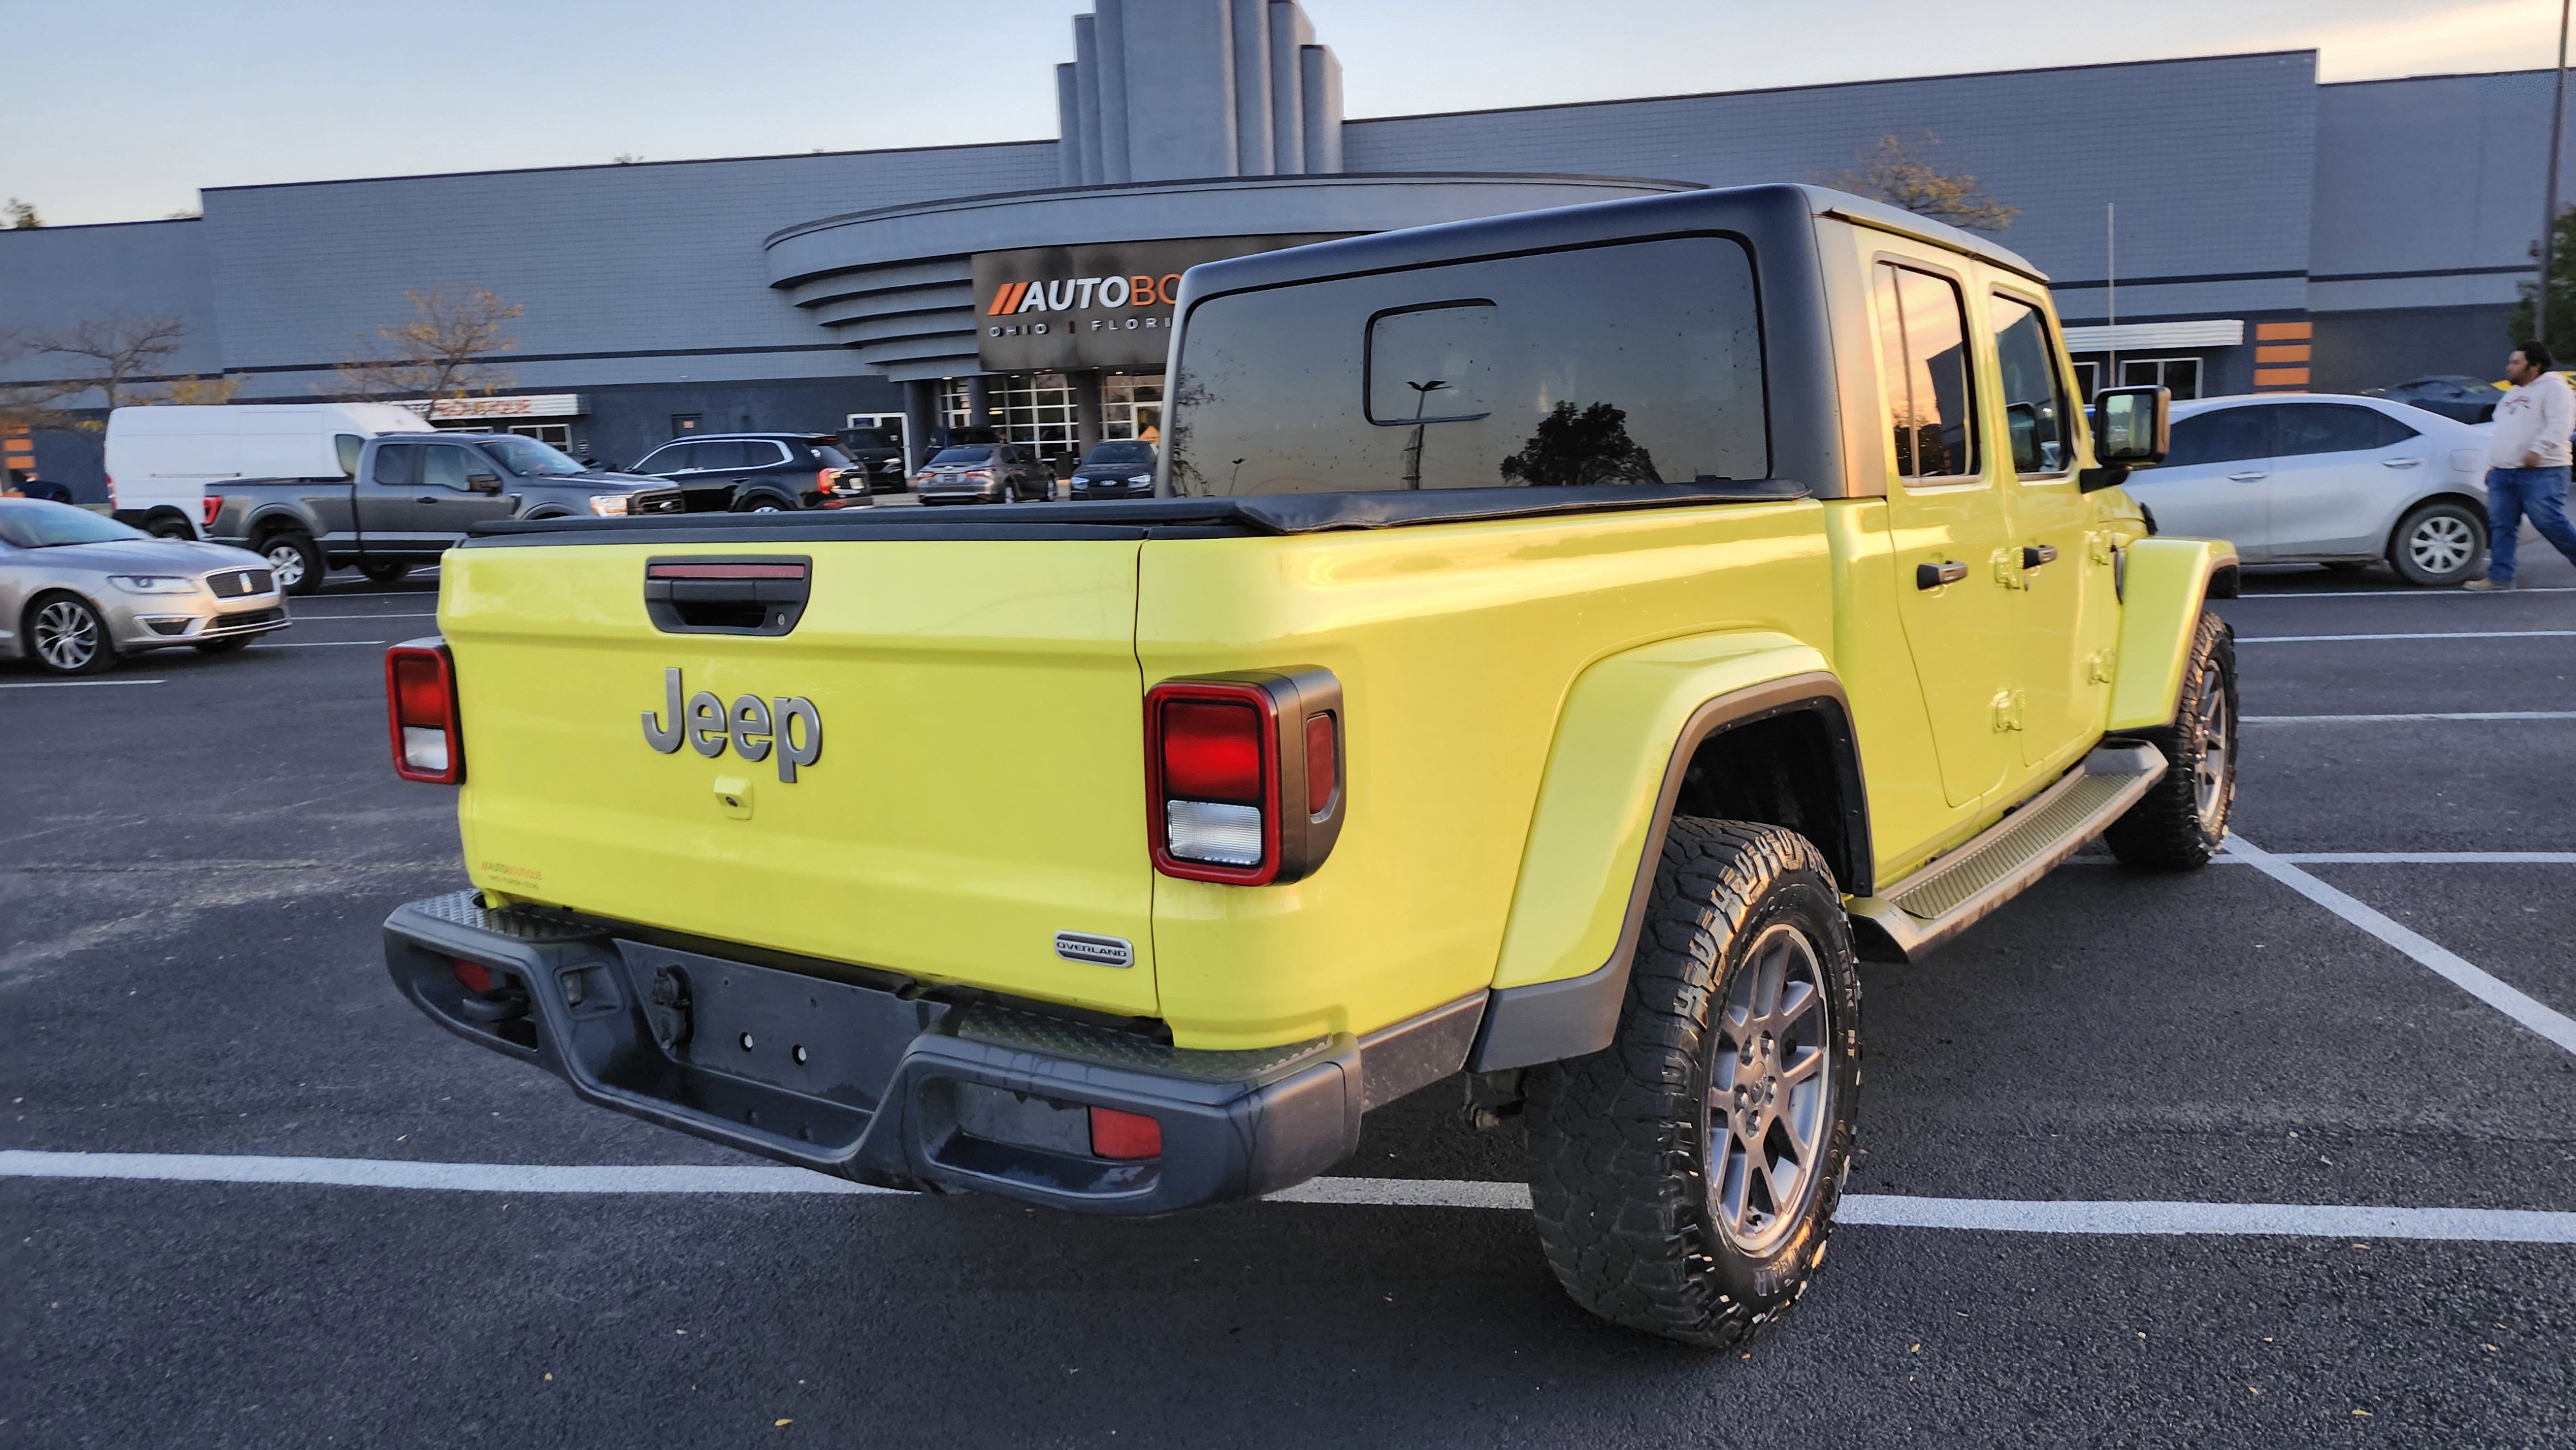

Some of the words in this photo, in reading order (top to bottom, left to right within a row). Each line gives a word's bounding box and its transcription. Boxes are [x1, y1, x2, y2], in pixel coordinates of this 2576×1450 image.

[989, 323, 1048, 337] OHIO
[1091, 317, 1171, 332] FLORI
[641, 667, 823, 783] Jeep
[1056, 941, 1127, 957] OVERLAND
